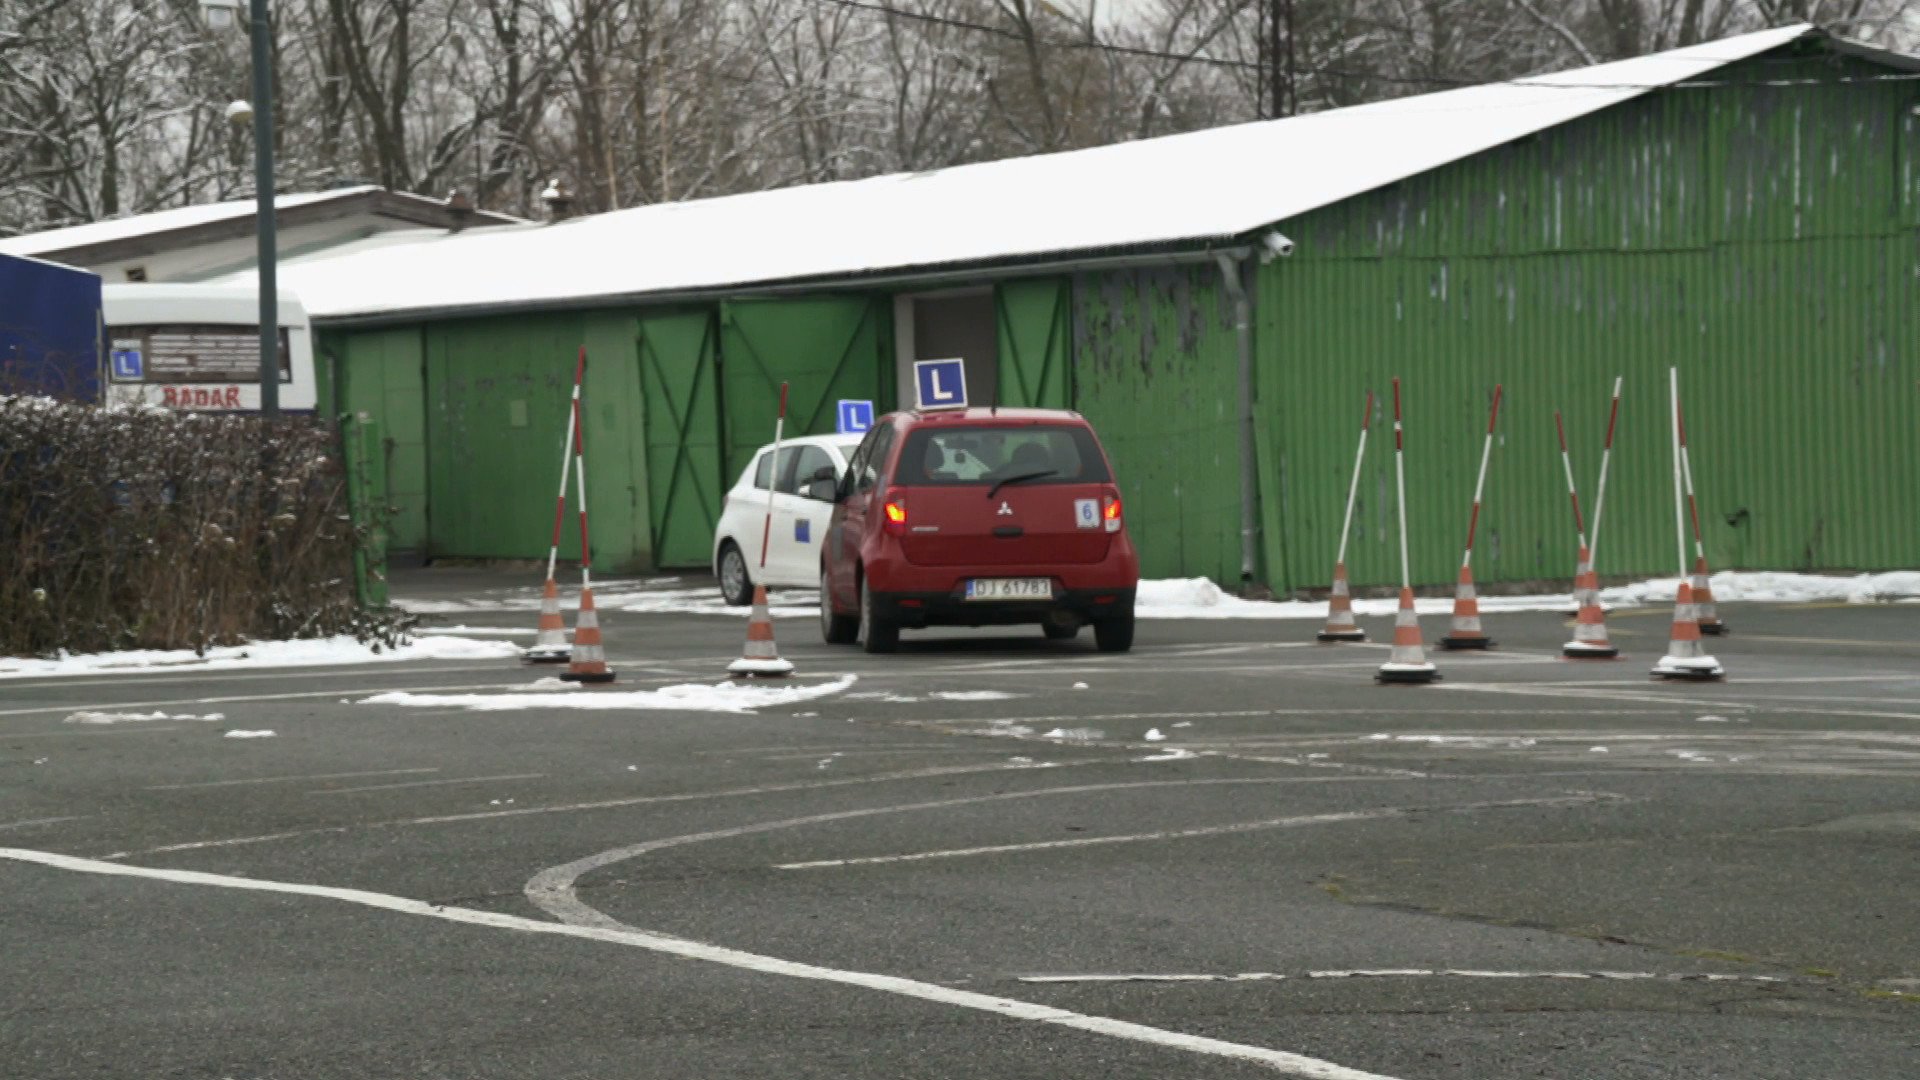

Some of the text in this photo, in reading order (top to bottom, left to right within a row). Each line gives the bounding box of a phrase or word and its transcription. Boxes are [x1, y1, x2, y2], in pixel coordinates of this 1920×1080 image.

[120, 354, 136, 374] L
[931, 368, 953, 400] L
[161, 386, 240, 407] RADAR
[850, 407, 866, 429] L
[1082, 504, 1093, 520] 6
